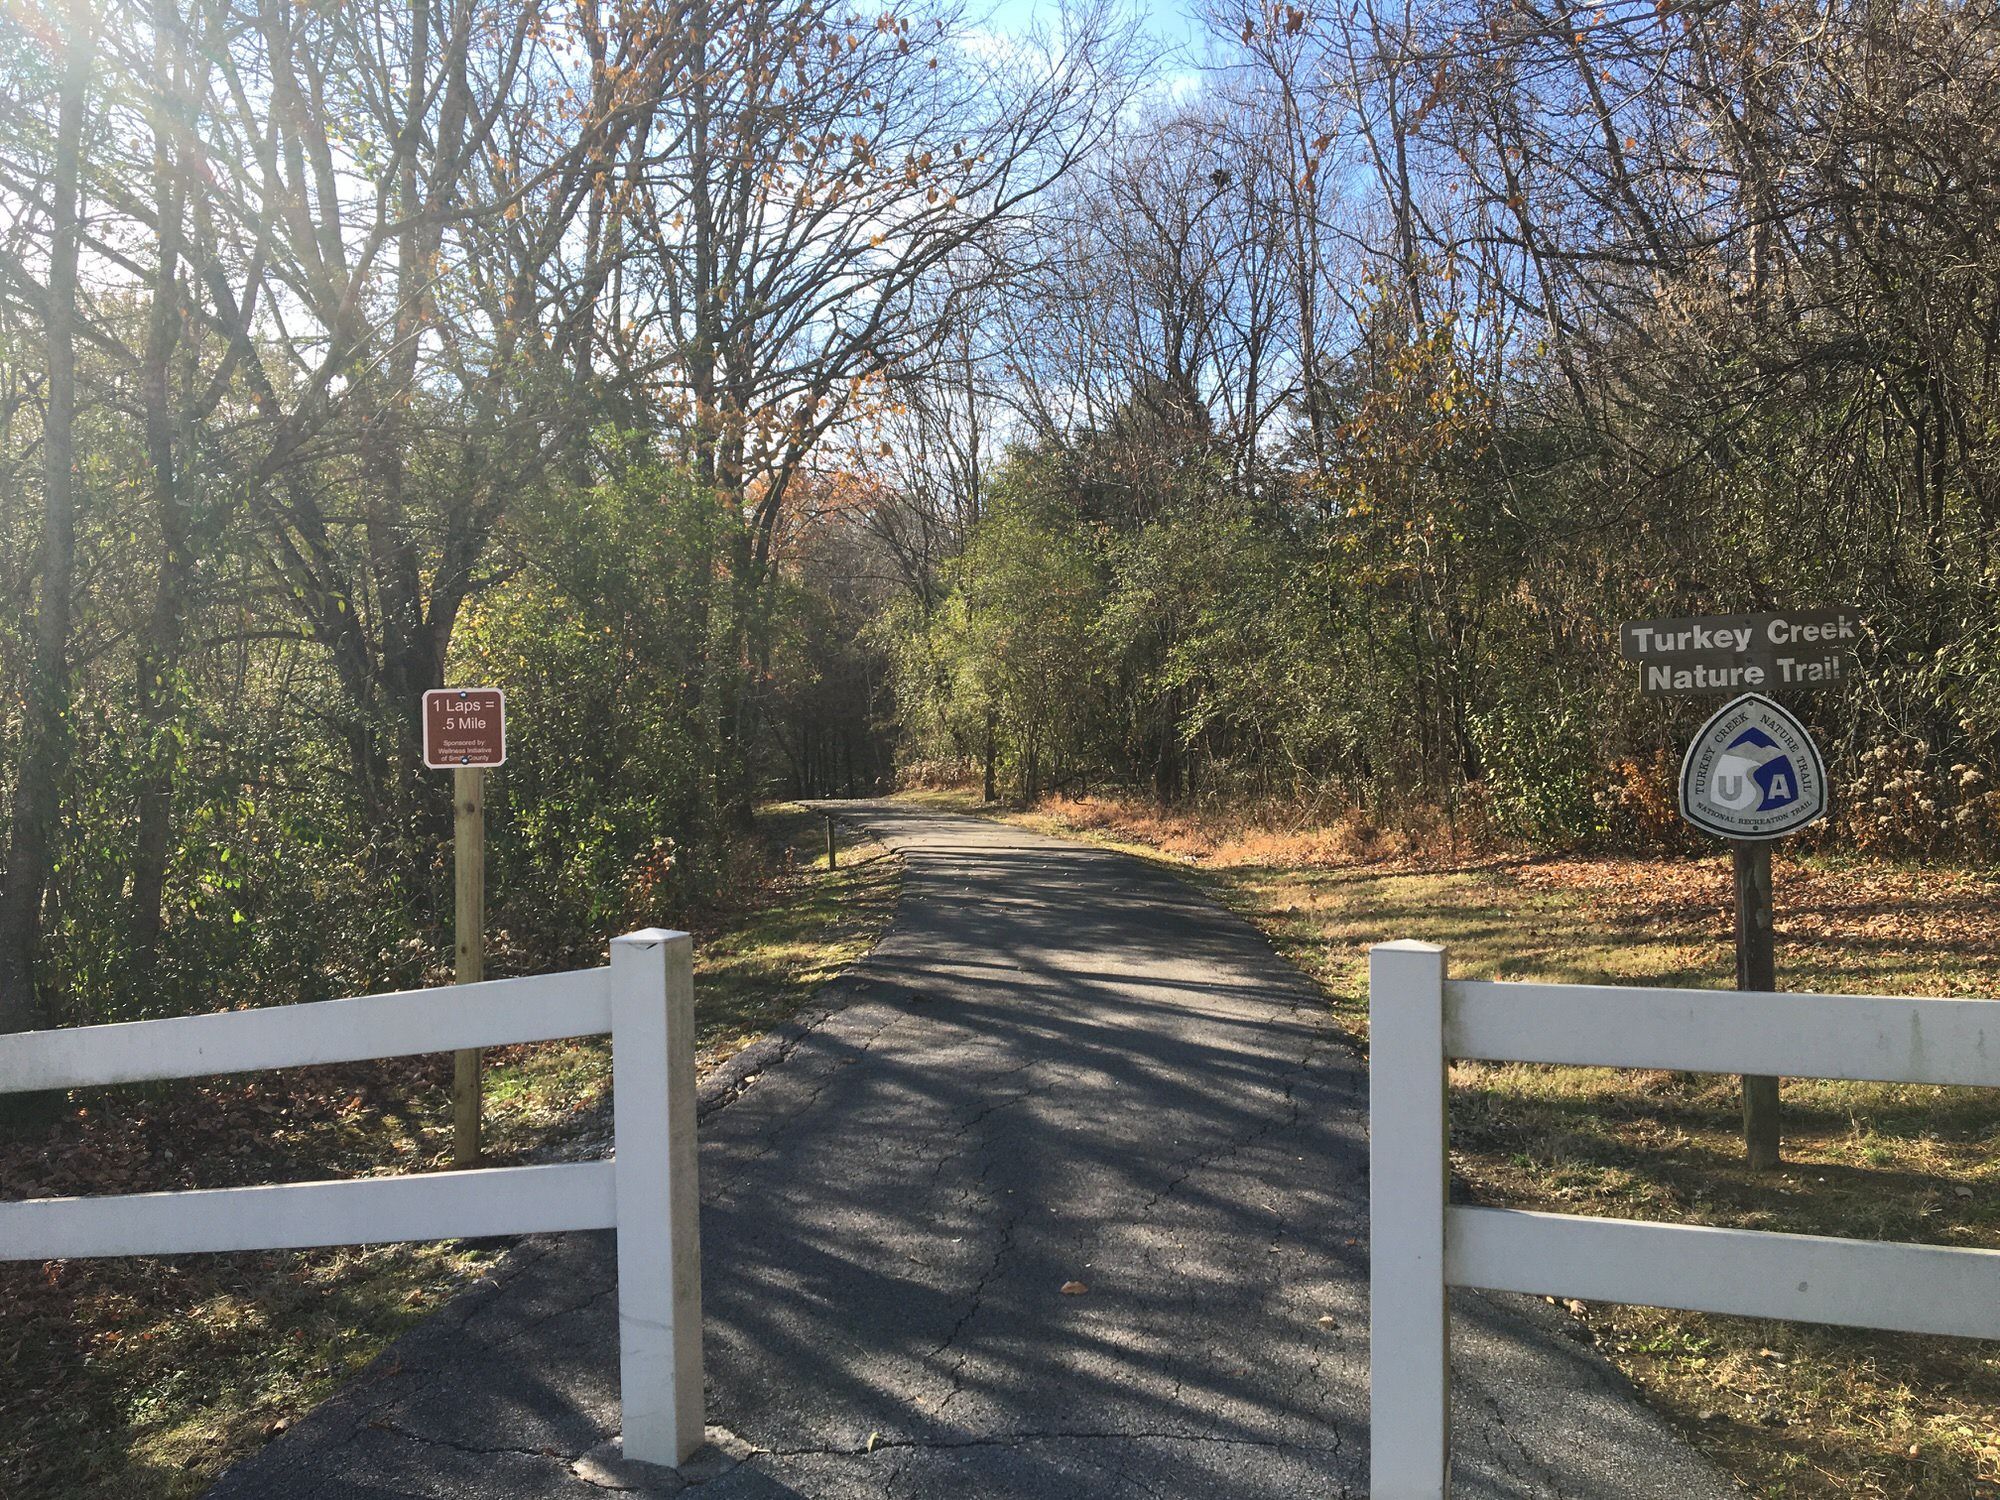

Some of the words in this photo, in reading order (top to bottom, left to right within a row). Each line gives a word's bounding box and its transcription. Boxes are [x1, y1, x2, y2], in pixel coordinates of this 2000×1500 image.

[1631, 624, 1753, 652] Turkey
[1767, 615, 1856, 644] Creek
[1648, 664, 1765, 690] Nature
[1776, 655, 1840, 683] Trail
[433, 699, 439, 712] 1
[446, 699, 481, 714] Laps
[442, 718, 455, 729] .5
[459, 717, 486, 729] Mile
[1695, 746, 1716, 795] TURKEY
[1714, 712, 1749, 743] CREEK
[1759, 714, 1800, 753] NATURE
[1796, 756, 1812, 792] TRAIL
[1696, 802, 1736, 824] NATIONAL
[1738, 813, 1789, 825] RECREATION
[1790, 800, 1813, 817] TRAIL
